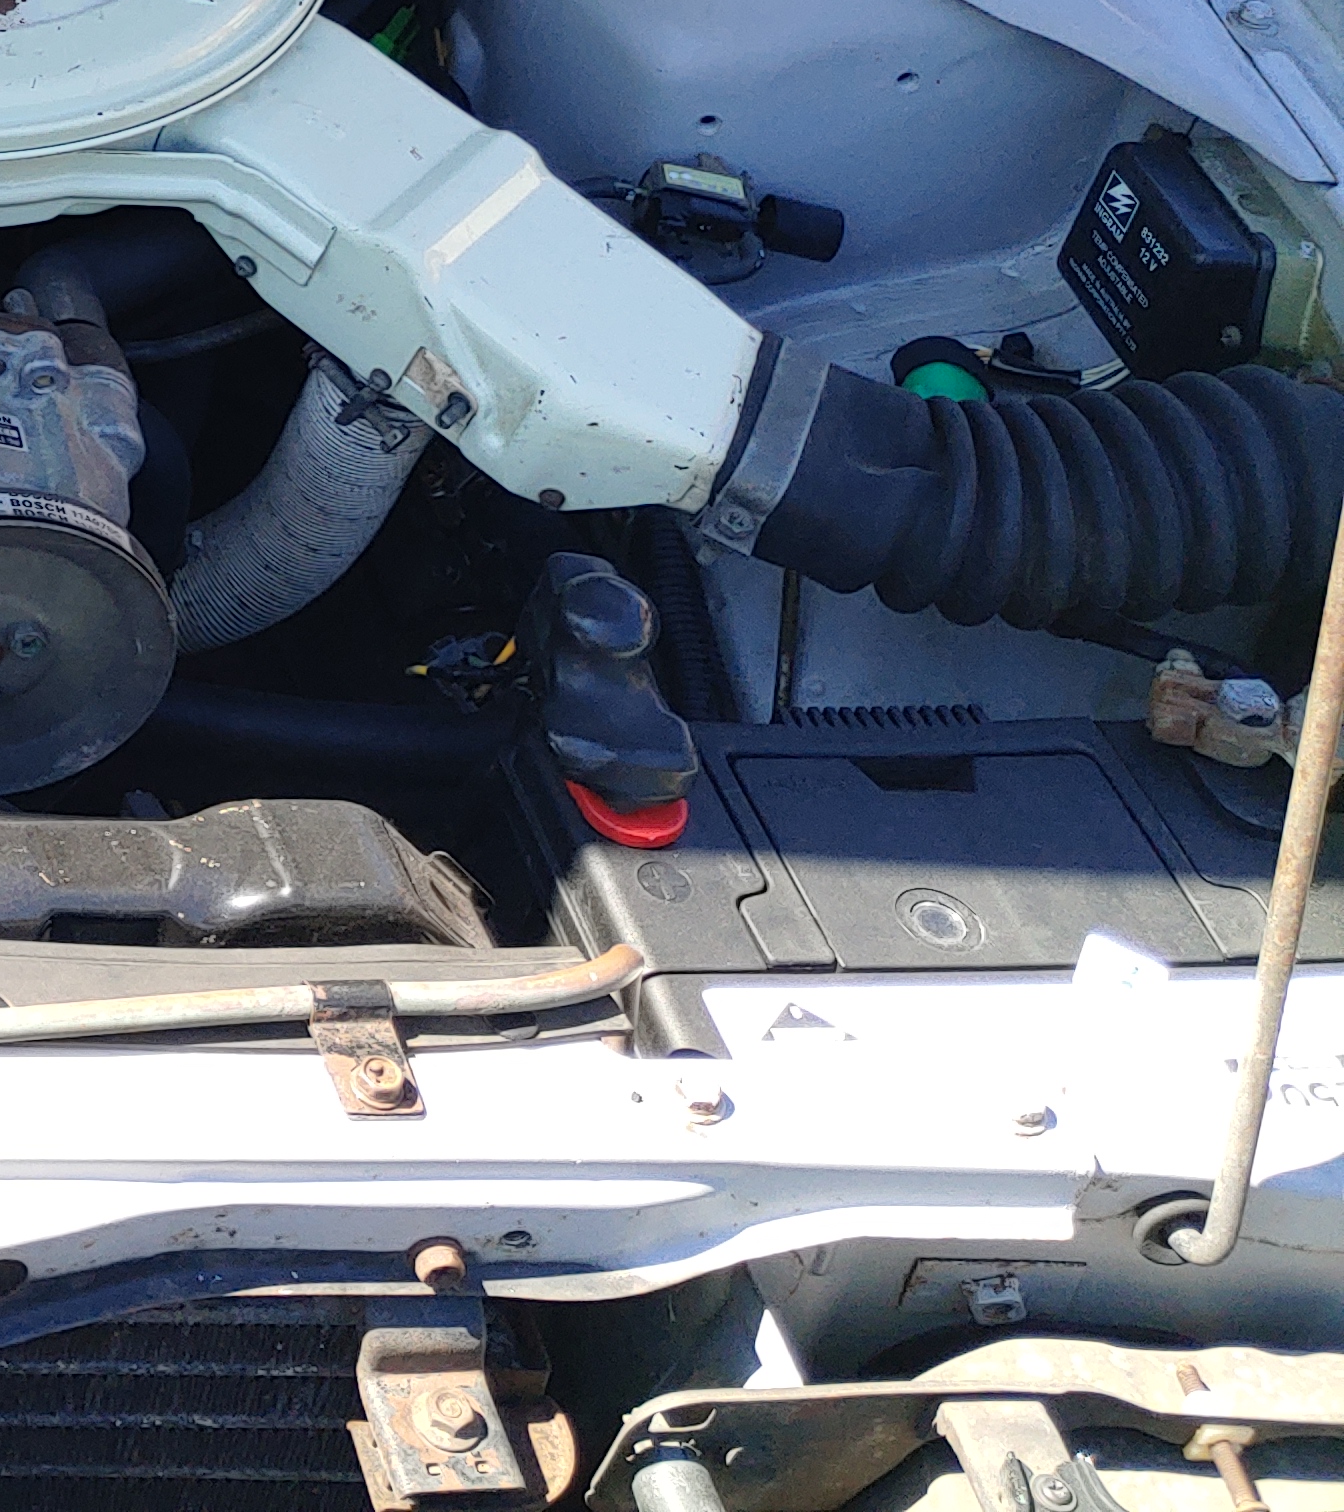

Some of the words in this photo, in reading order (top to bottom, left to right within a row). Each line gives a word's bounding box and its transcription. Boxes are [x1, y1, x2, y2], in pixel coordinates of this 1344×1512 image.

[1093, 202, 1125, 244] INGRAM
[1138, 247, 1151, 264] 12
[10, 498, 67, 516] BOSCH
